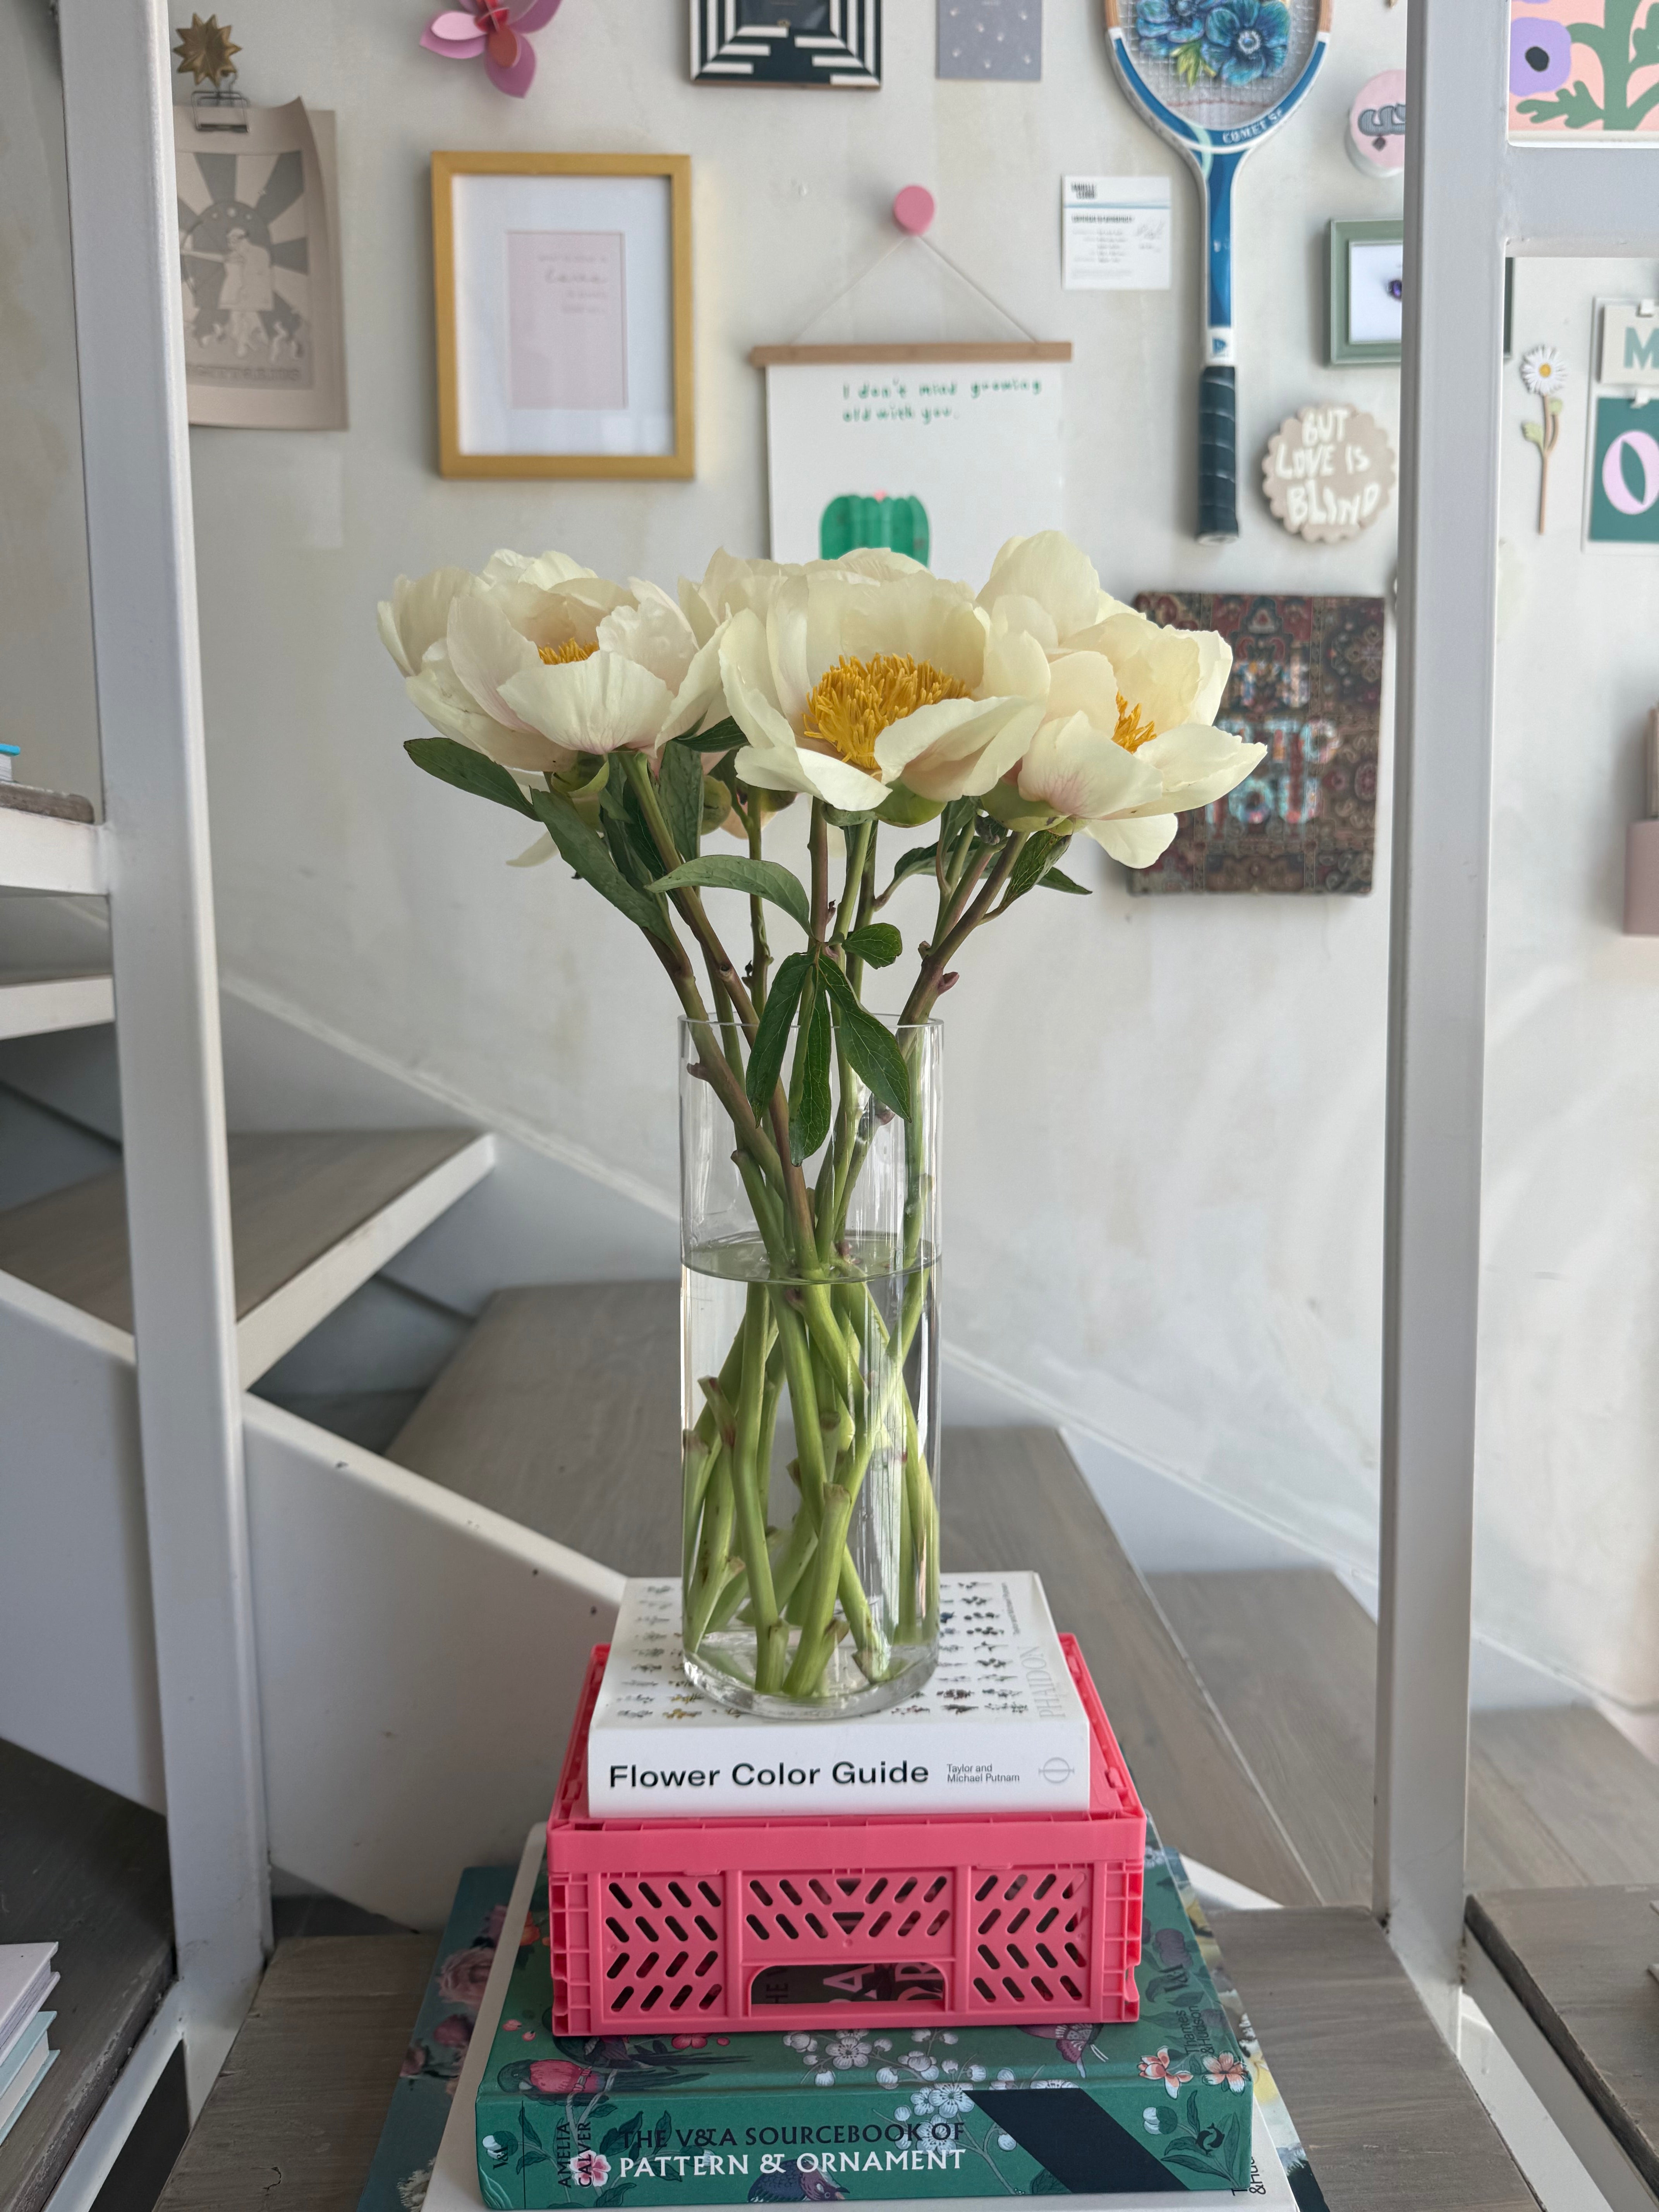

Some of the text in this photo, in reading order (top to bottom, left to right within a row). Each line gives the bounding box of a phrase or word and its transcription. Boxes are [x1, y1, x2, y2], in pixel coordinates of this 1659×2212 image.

[1222, 120, 1267, 144] COMET
[843, 383, 850, 400] I
[858, 378, 907, 398] don't
[919, 381, 957, 396] mind
[1302, 407, 1349, 447] BUT
[1275, 443, 1371, 480] LOVE IS
[1286, 479, 1381, 525] BLIND
[1017, 1646, 1066, 1718] PHAIDON
[610, 1760, 929, 1787] Flower Color Guide
[947, 1764, 992, 1774] Taylor and
[947, 1773, 1020, 1782] Michael Putnam
[1176, 2010, 1199, 2055] Thames
[623, 2122, 965, 2148] THE V&A SOURCEBOOK OF
[556, 2122, 572, 2188] AMELIA
[577, 2121, 592, 2188] CALVER
[620, 2149, 966, 2177] PATTERN & ORNAMENT
